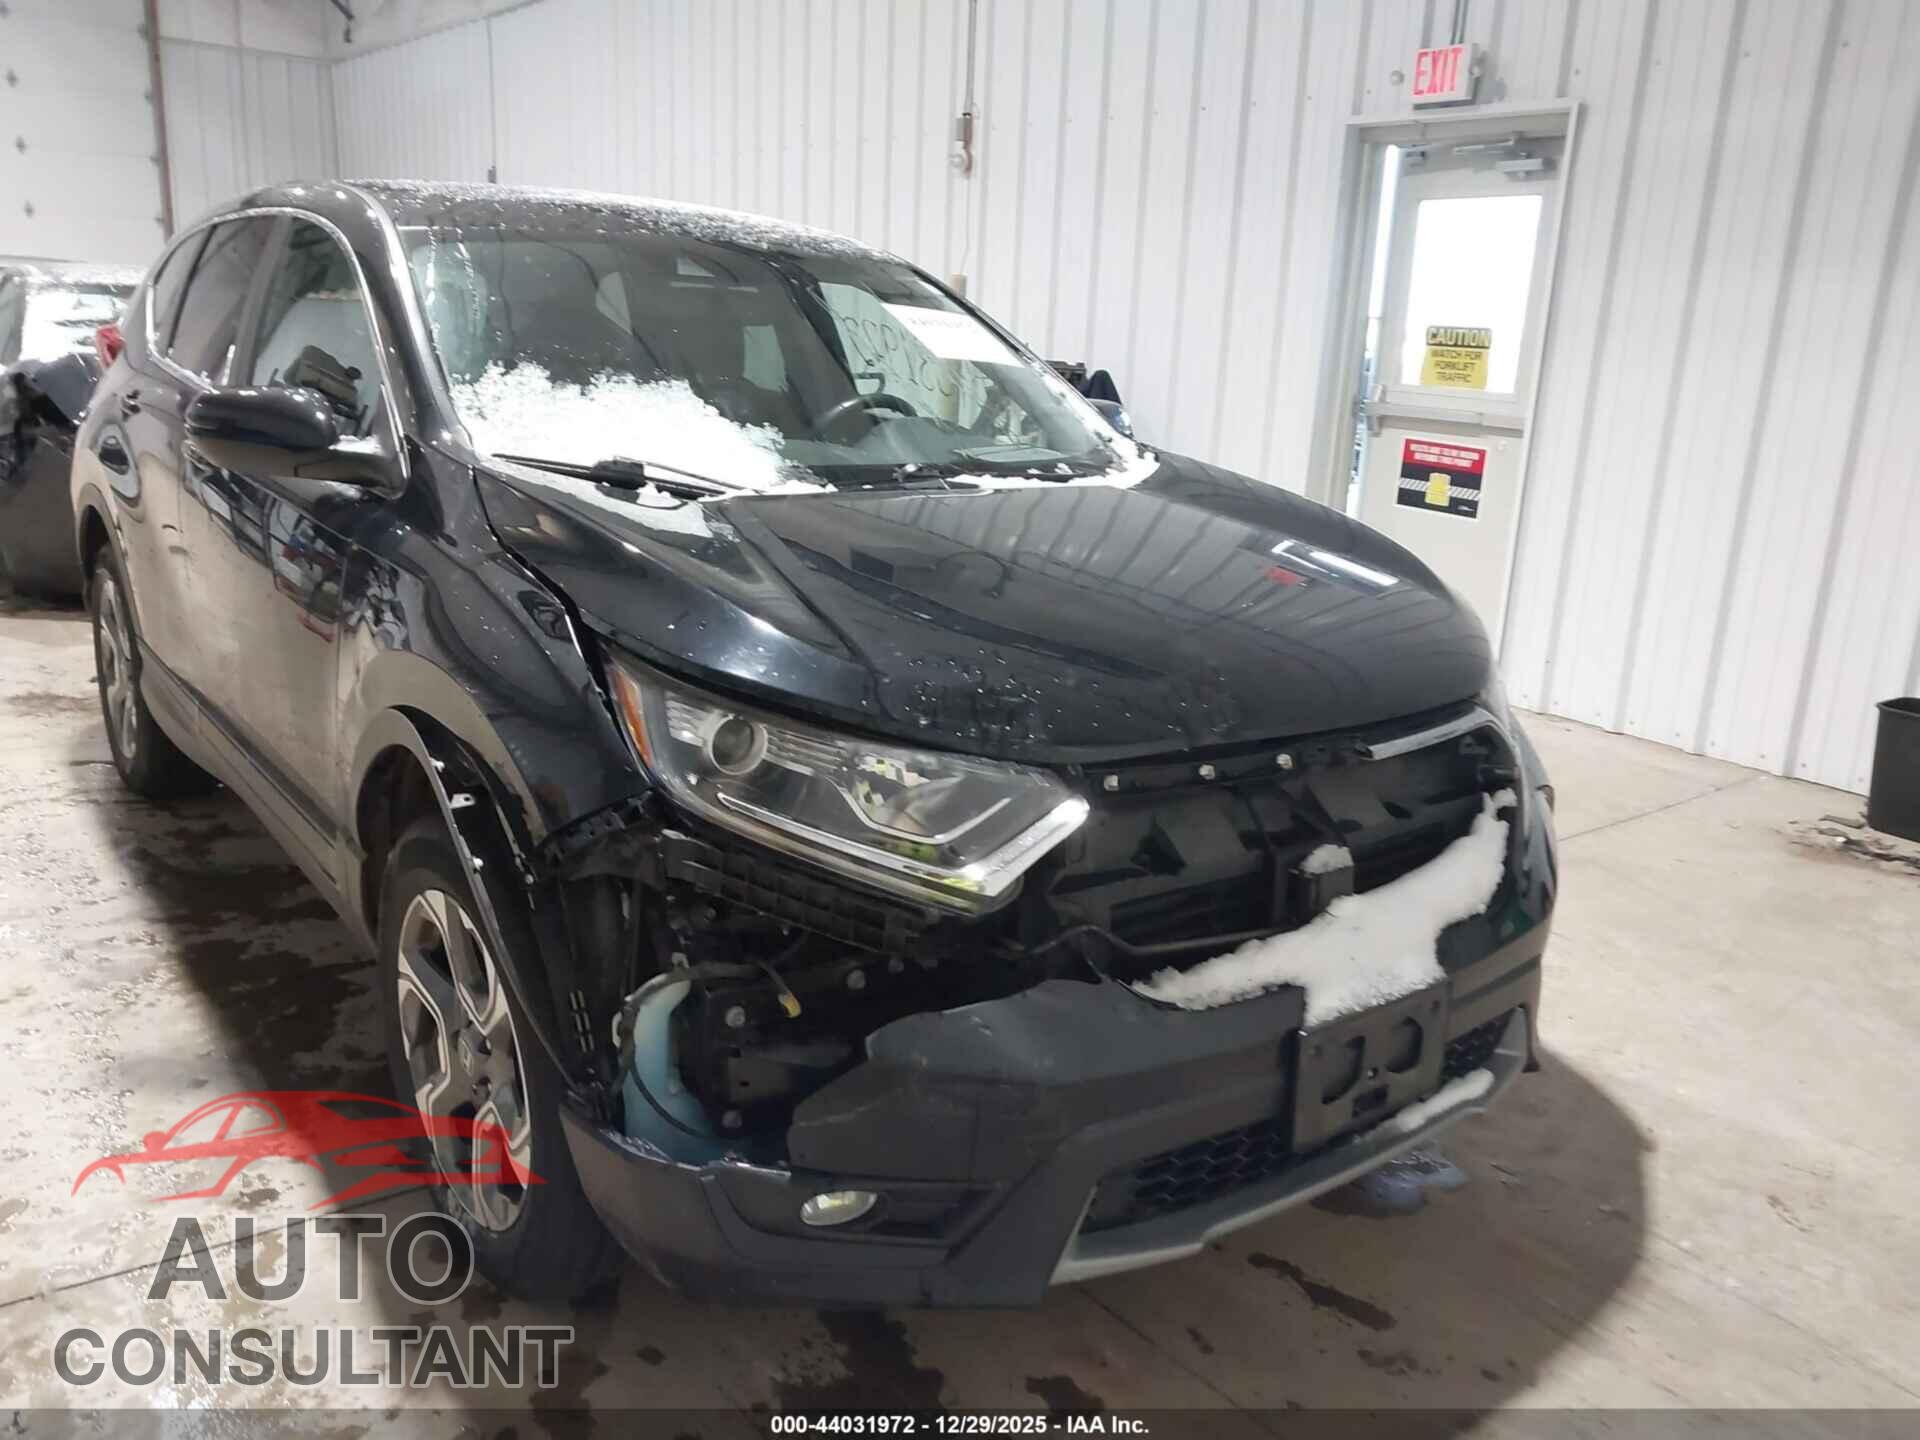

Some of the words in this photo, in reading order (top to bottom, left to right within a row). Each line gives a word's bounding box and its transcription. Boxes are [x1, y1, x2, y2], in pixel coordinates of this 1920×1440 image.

[1413, 48, 1463, 95] EXIT
[1427, 327, 1489, 348] CAUTION
[1431, 348, 1461, 359] WATCH
[1464, 350, 1482, 361] FOR
[1433, 359, 1476, 371] FORKLIFT
[1435, 371, 1473, 383] TRAFFIC
